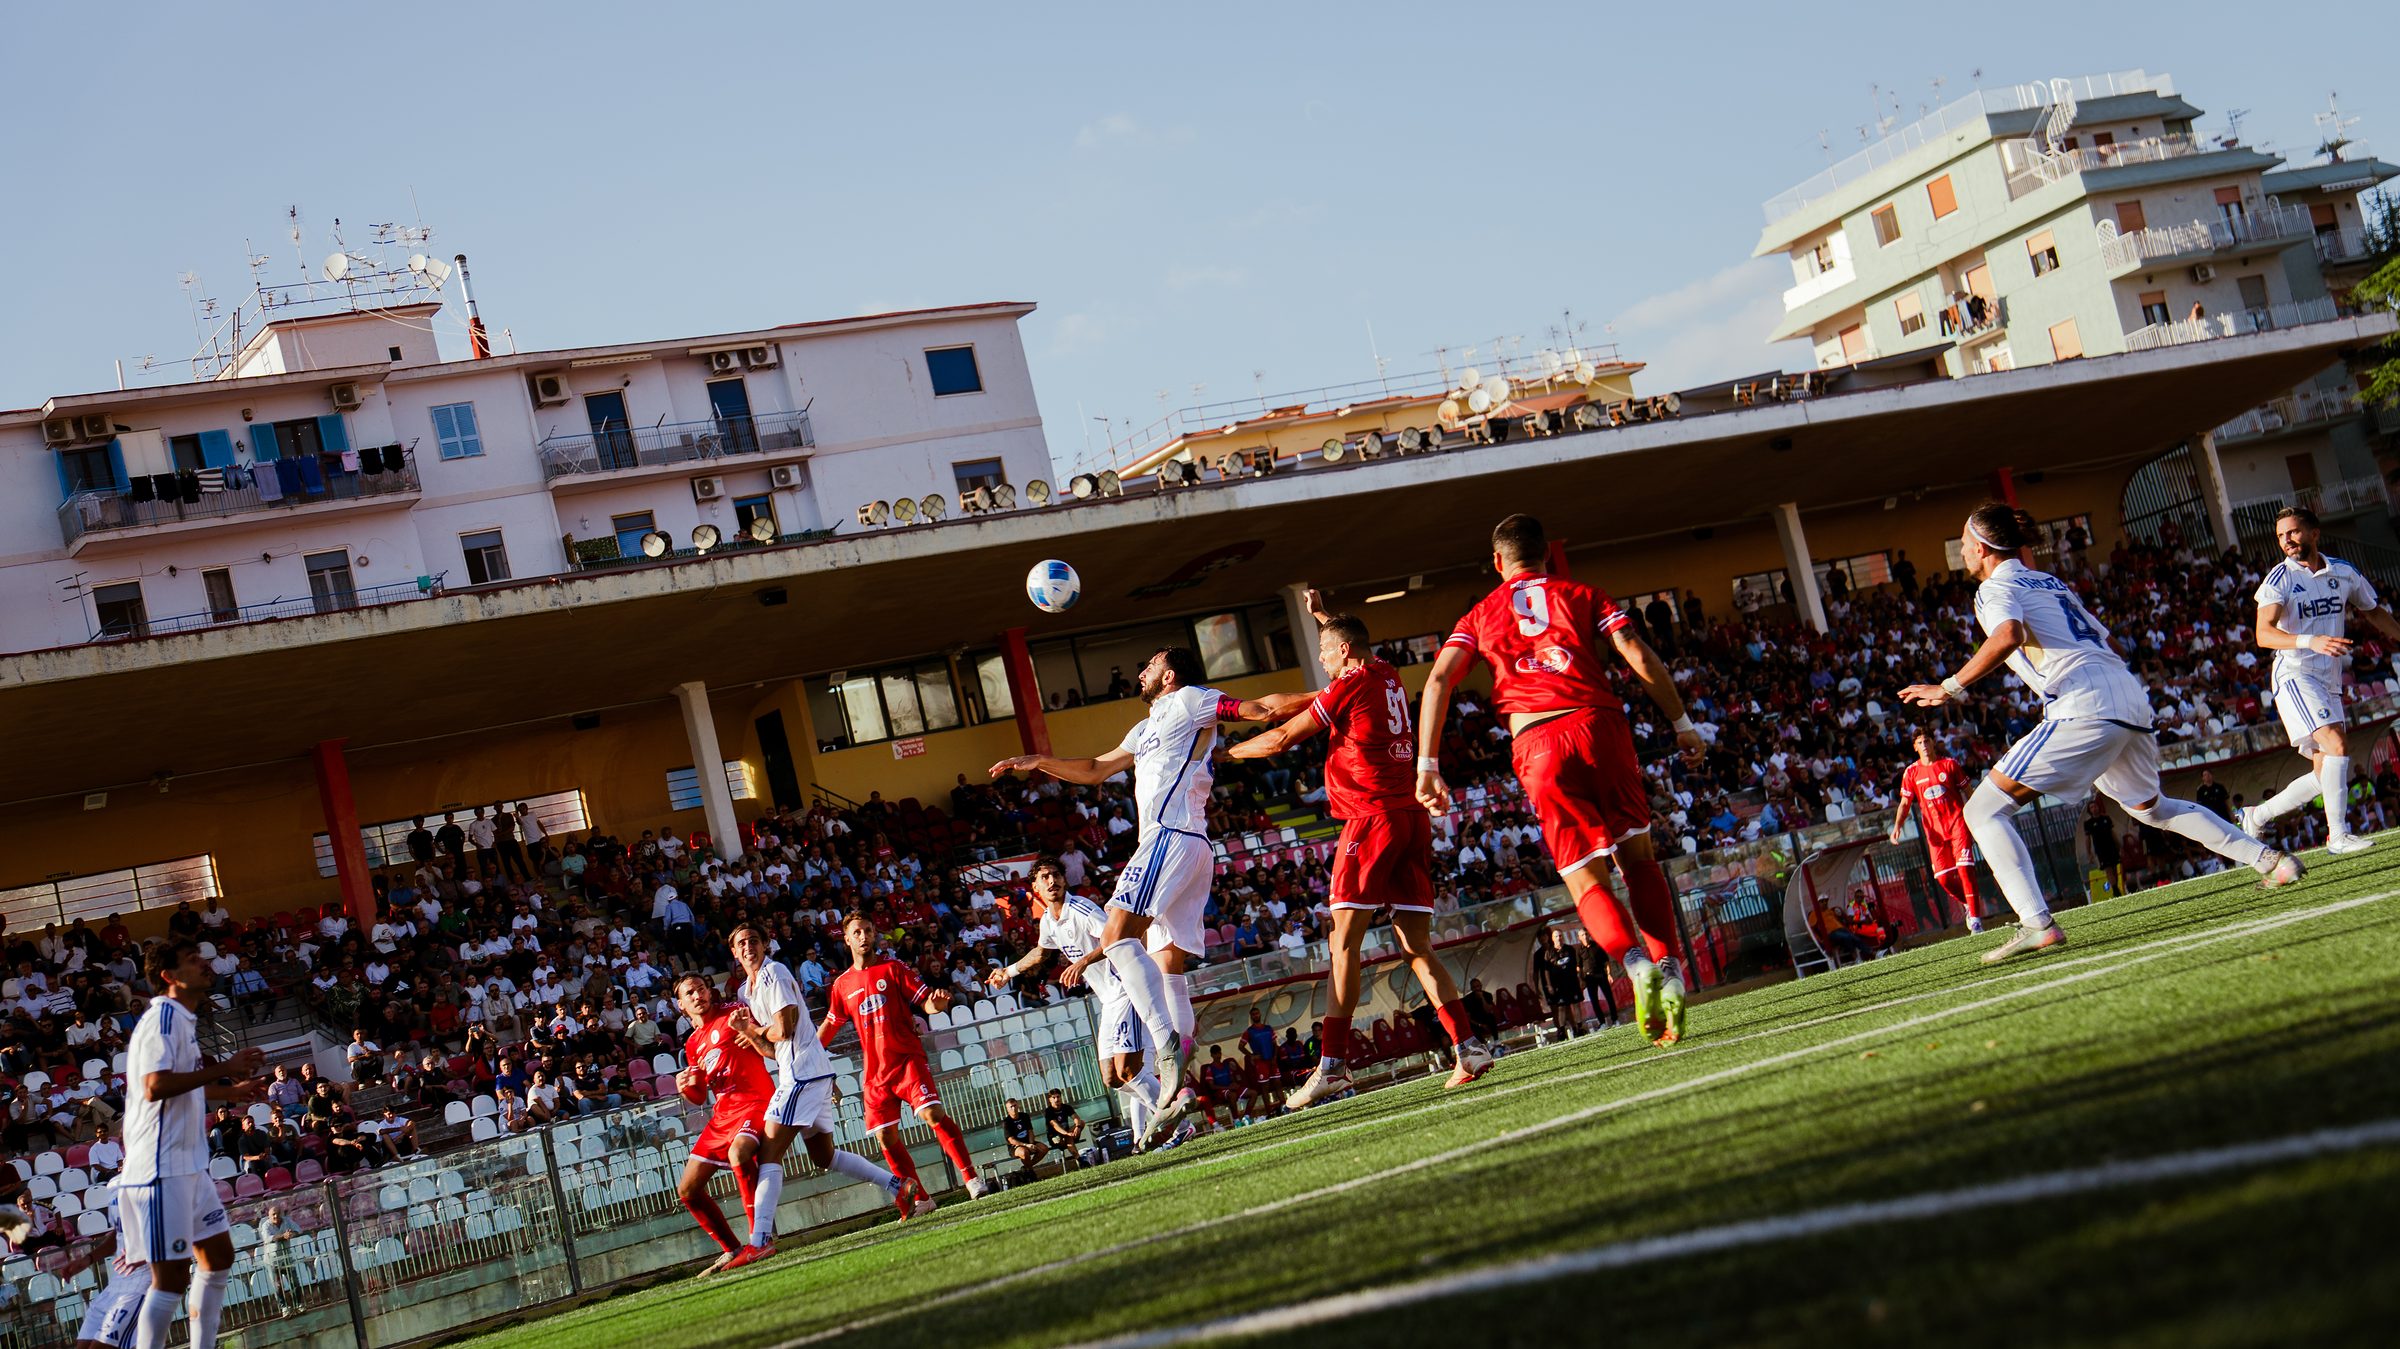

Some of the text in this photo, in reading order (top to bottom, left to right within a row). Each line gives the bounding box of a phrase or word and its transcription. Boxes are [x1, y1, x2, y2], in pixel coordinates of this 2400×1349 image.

[1512, 586, 1549, 637] 9
[2054, 593, 2105, 650] 4
[1385, 686, 1412, 734] 91
[920, 1084, 929, 1095] 6
